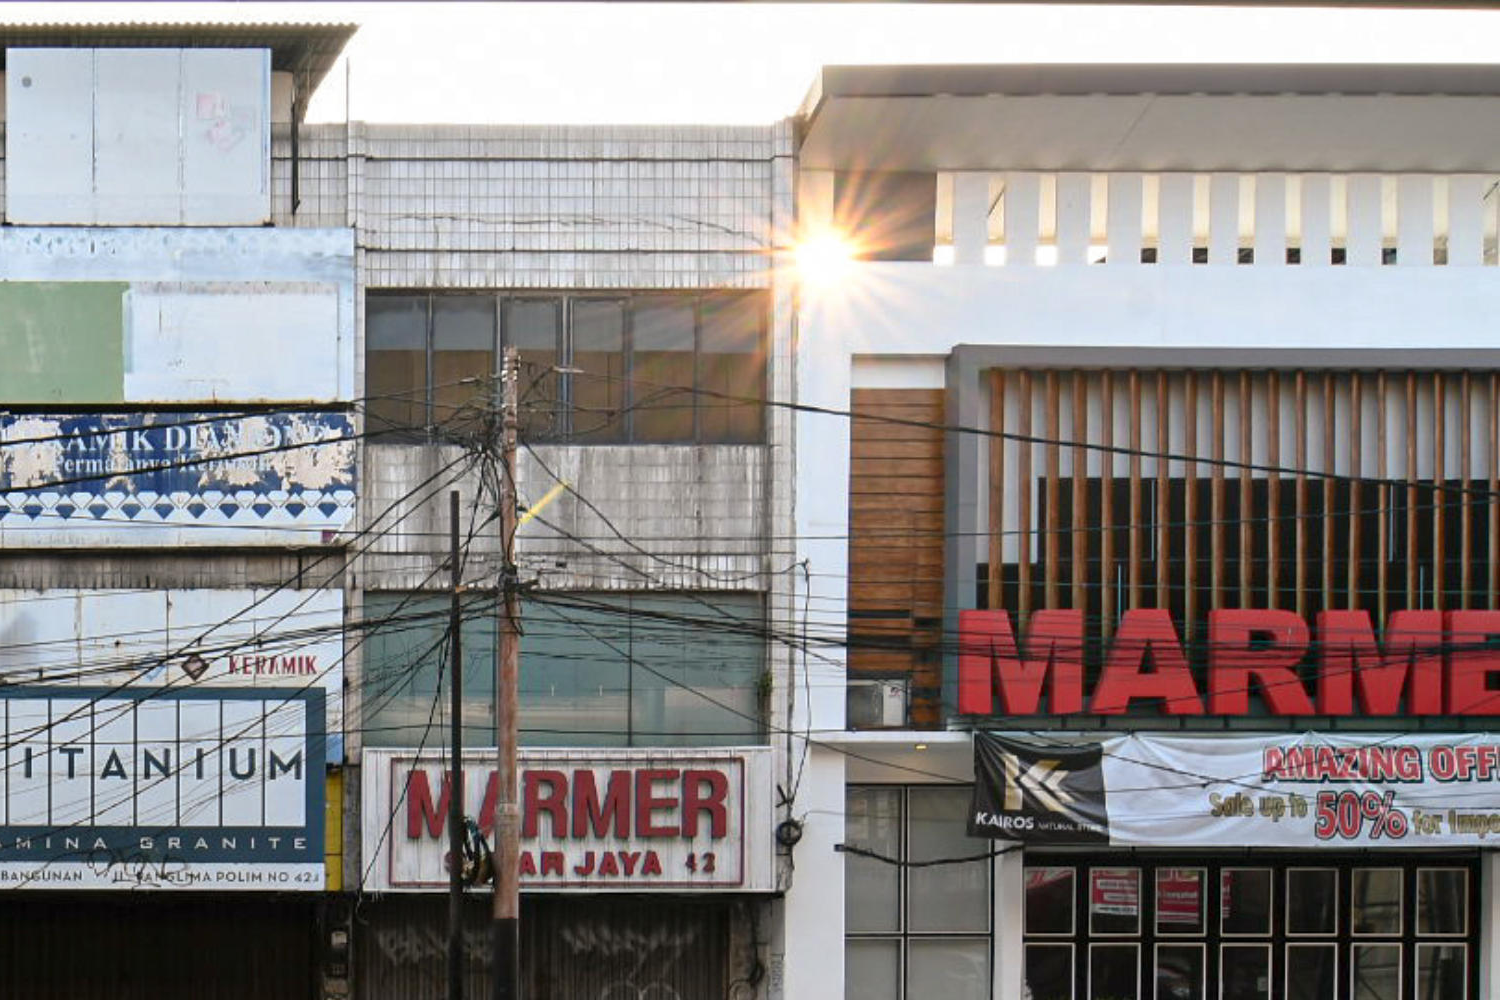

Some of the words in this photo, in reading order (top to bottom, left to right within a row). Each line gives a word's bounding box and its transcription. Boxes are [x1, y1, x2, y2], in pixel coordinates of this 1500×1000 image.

[229, 654, 318, 676] KERAMIK
[1262, 745, 1424, 784] AMAZING
[1428, 745, 1500, 784] OFF
[975, 811, 1035, 831] KAIROS
[1209, 792, 1255, 818] Sale
[1259, 795, 1286, 823] up
[1314, 789, 1409, 840] 50%
[1412, 811, 1444, 836] for
[140, 836, 307, 850] GRANITE
[574, 850, 663, 877] JAYA
[1, 870, 83, 882] BANGUNAN
[216, 870, 263, 883] POLIM
[268, 870, 290, 883] NO
